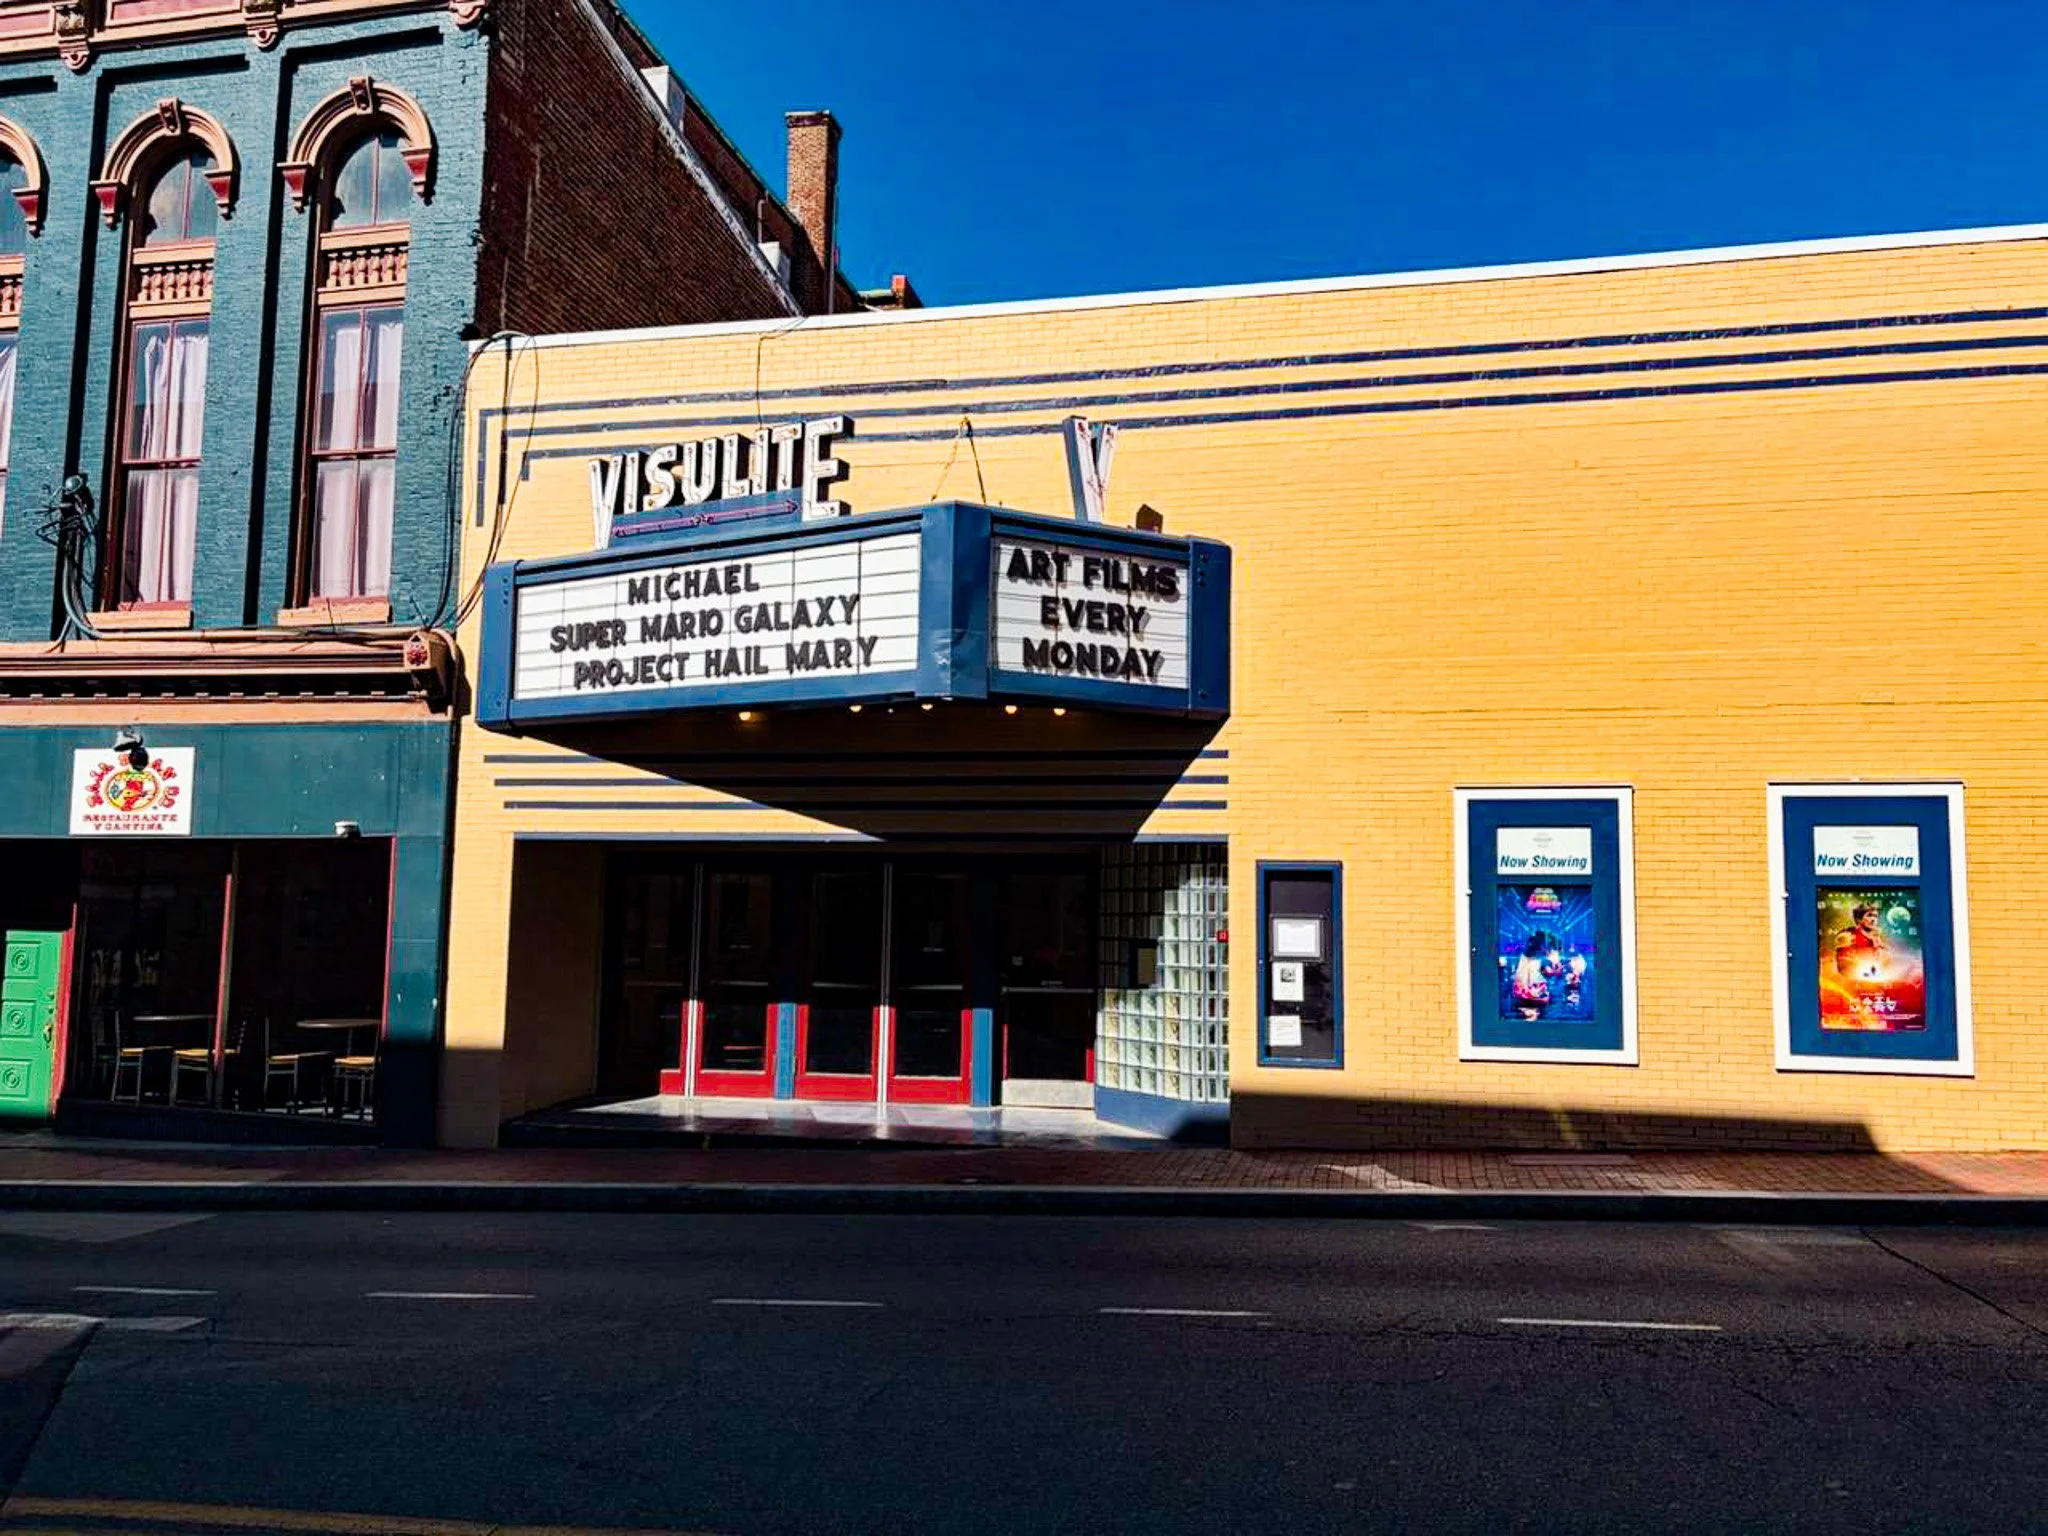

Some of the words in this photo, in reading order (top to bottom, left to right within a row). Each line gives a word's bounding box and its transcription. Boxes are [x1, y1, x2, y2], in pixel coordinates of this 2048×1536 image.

[589, 415, 851, 549] VISULITE
[628, 563, 759, 605] MICHAEL
[1006, 548, 1070, 587] ART
[1083, 556, 1180, 600] FILMS
[550, 619, 627, 653] SUPER
[640, 608, 723, 643] MARIO
[735, 594, 860, 633] GALAXY
[1041, 596, 1150, 639] EVERY
[574, 652, 689, 689] PROJECT
[705, 648, 769, 679] HAIL
[785, 636, 878, 675] MARY
[1022, 638, 1164, 682] MONDAY
[1500, 855, 1528, 868] Now
[1532, 854, 1588, 871] Showing
[1817, 853, 1848, 867] Now
[1852, 853, 1914, 870] Showing
